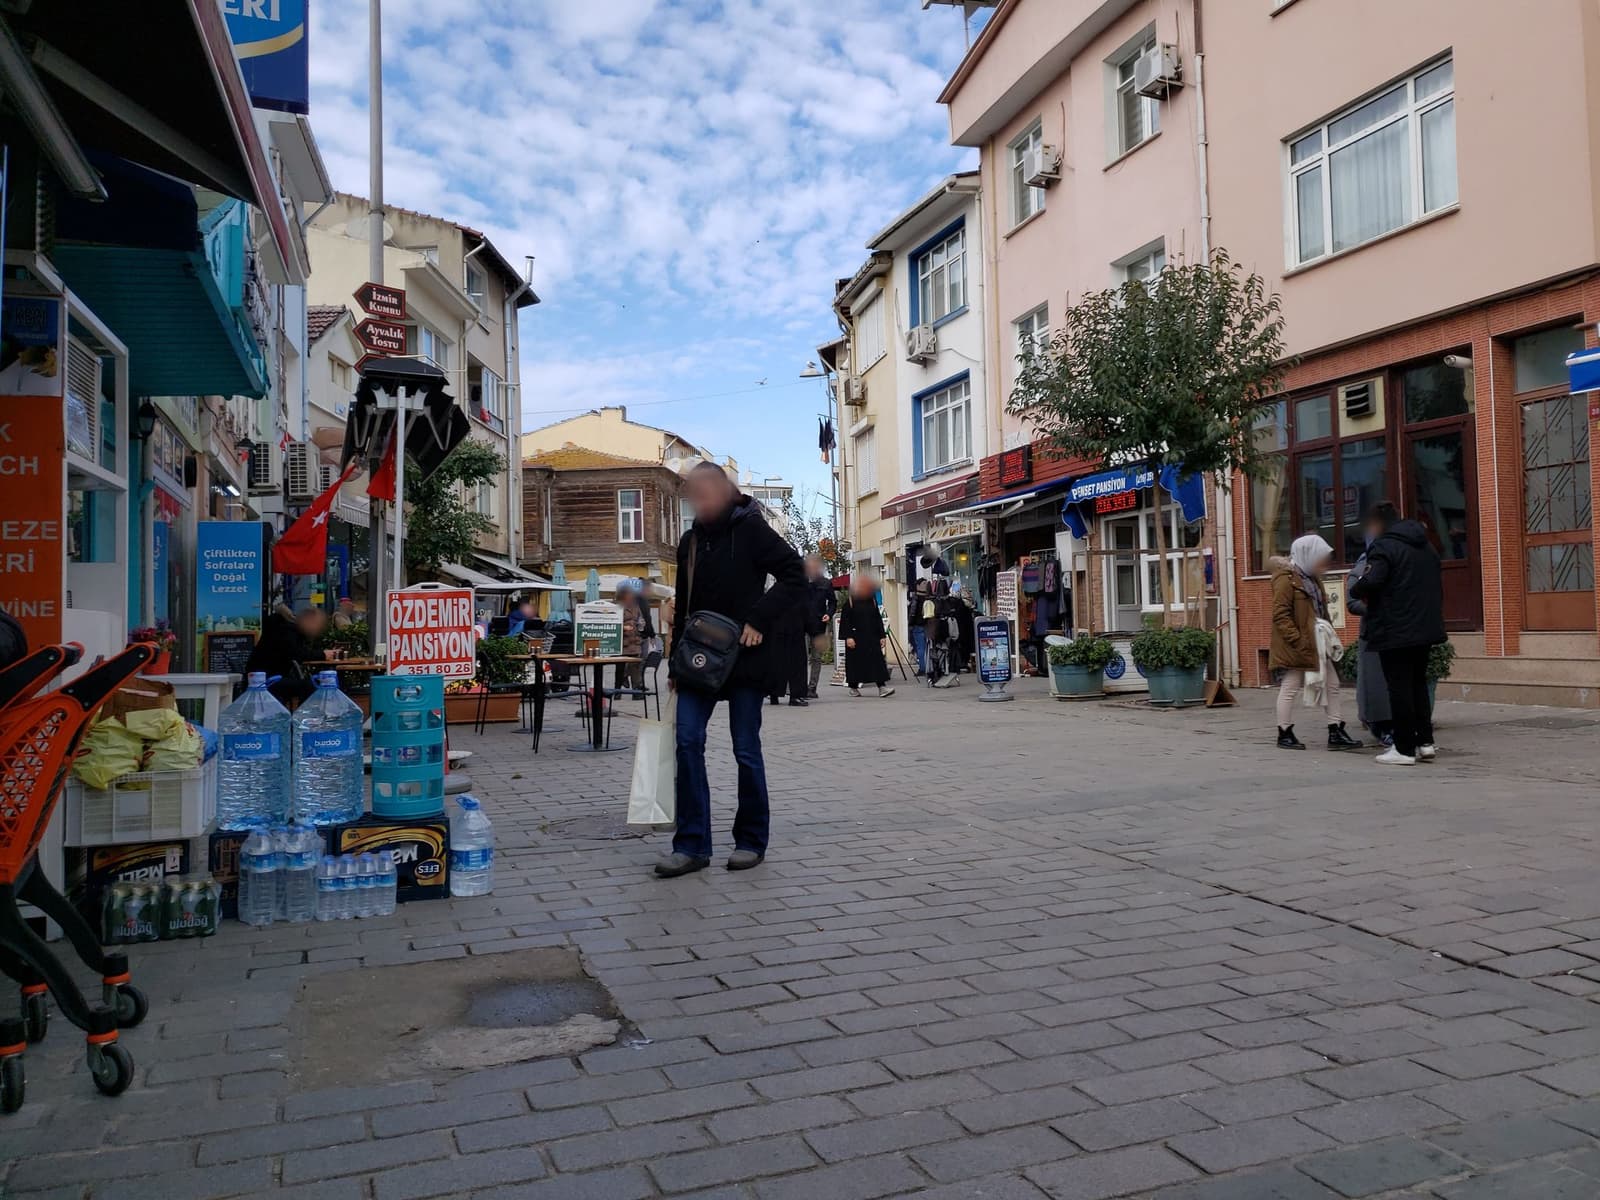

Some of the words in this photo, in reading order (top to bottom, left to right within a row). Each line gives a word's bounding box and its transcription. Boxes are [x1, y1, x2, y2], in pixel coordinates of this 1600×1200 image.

[203, 549, 256, 560] Çiftlikten
[205, 561, 255, 570] Sofralara
[214, 572, 247, 583] Doğal
[211, 585, 248, 593] Lezzet
[408, 665, 430, 675] 351
[436, 664, 451, 674] 80
[455, 663, 470, 673] 26
[418, 864, 440, 874] EFES
